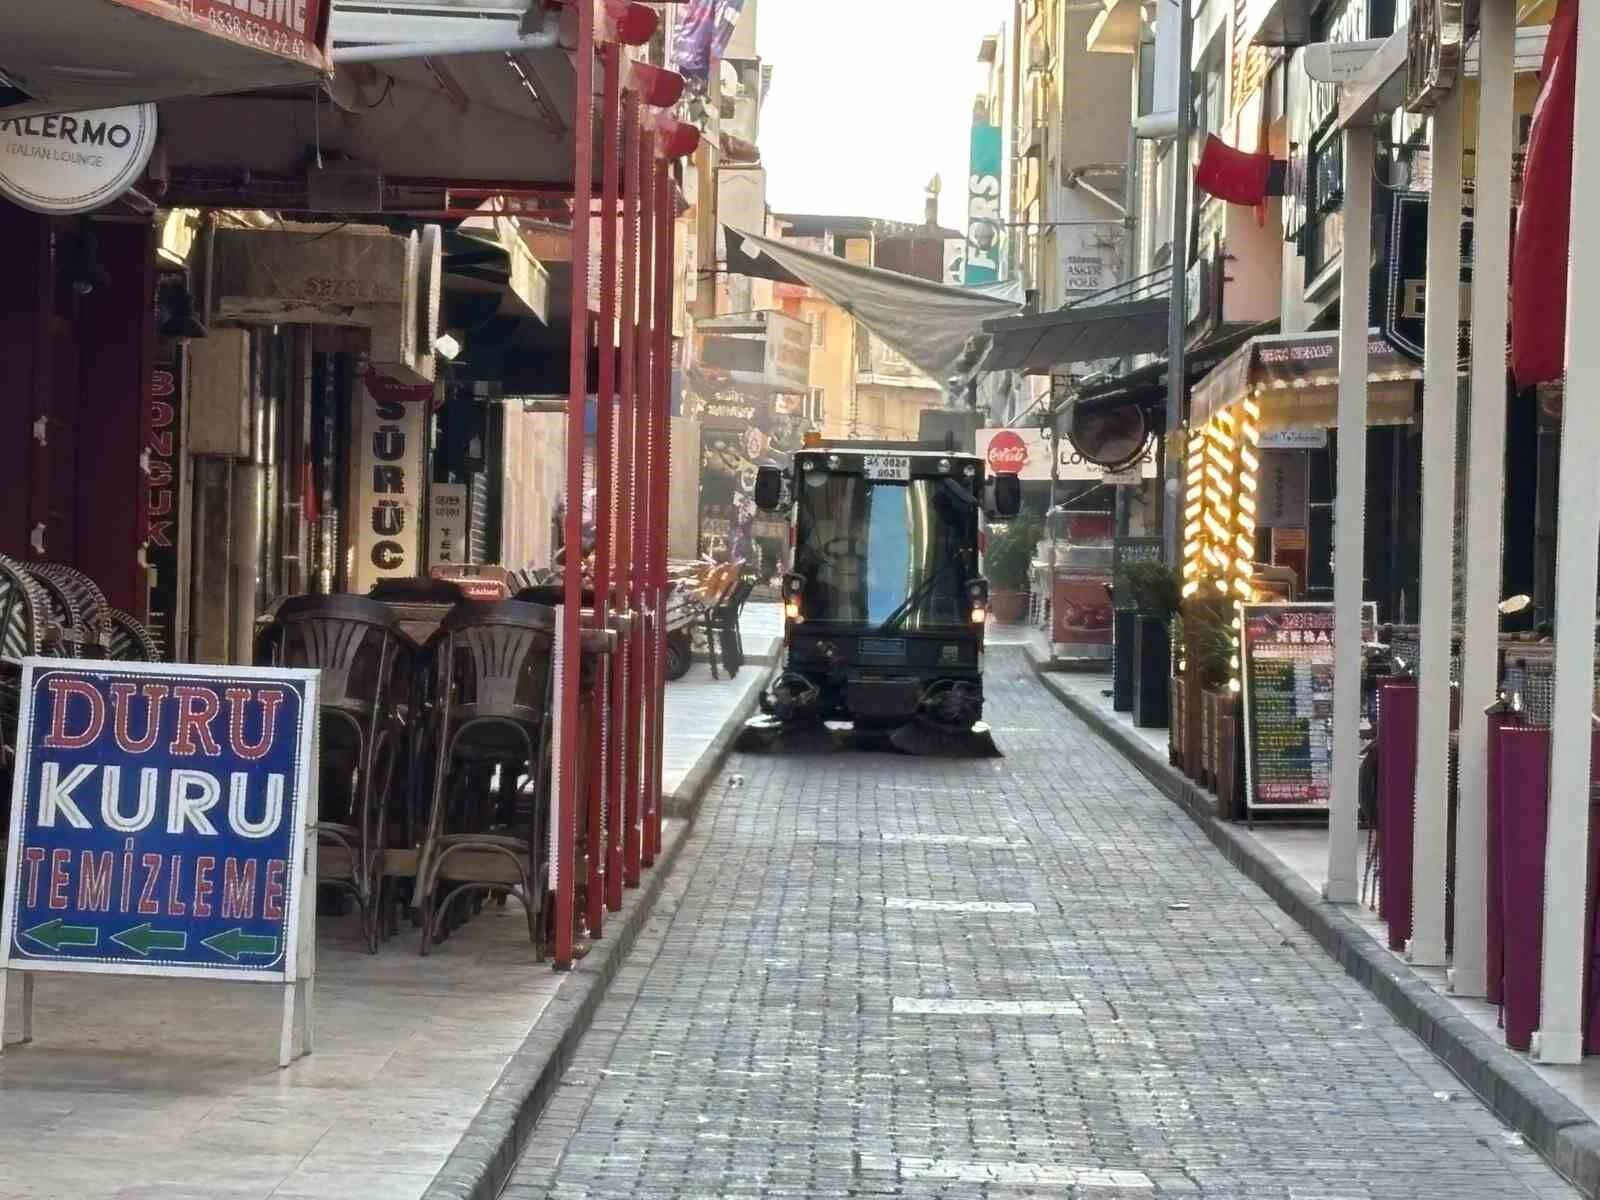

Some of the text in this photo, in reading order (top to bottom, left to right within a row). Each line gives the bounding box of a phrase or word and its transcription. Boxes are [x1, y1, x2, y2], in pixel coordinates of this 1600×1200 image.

[5, 143, 105, 168] ITALIAN LOUNGE
[1276, 631, 1336, 643] KEBA
[44, 679, 285, 760] DURU
[37, 762, 285, 839] KURU
[26, 837, 287, 921] TEMİZLEME
